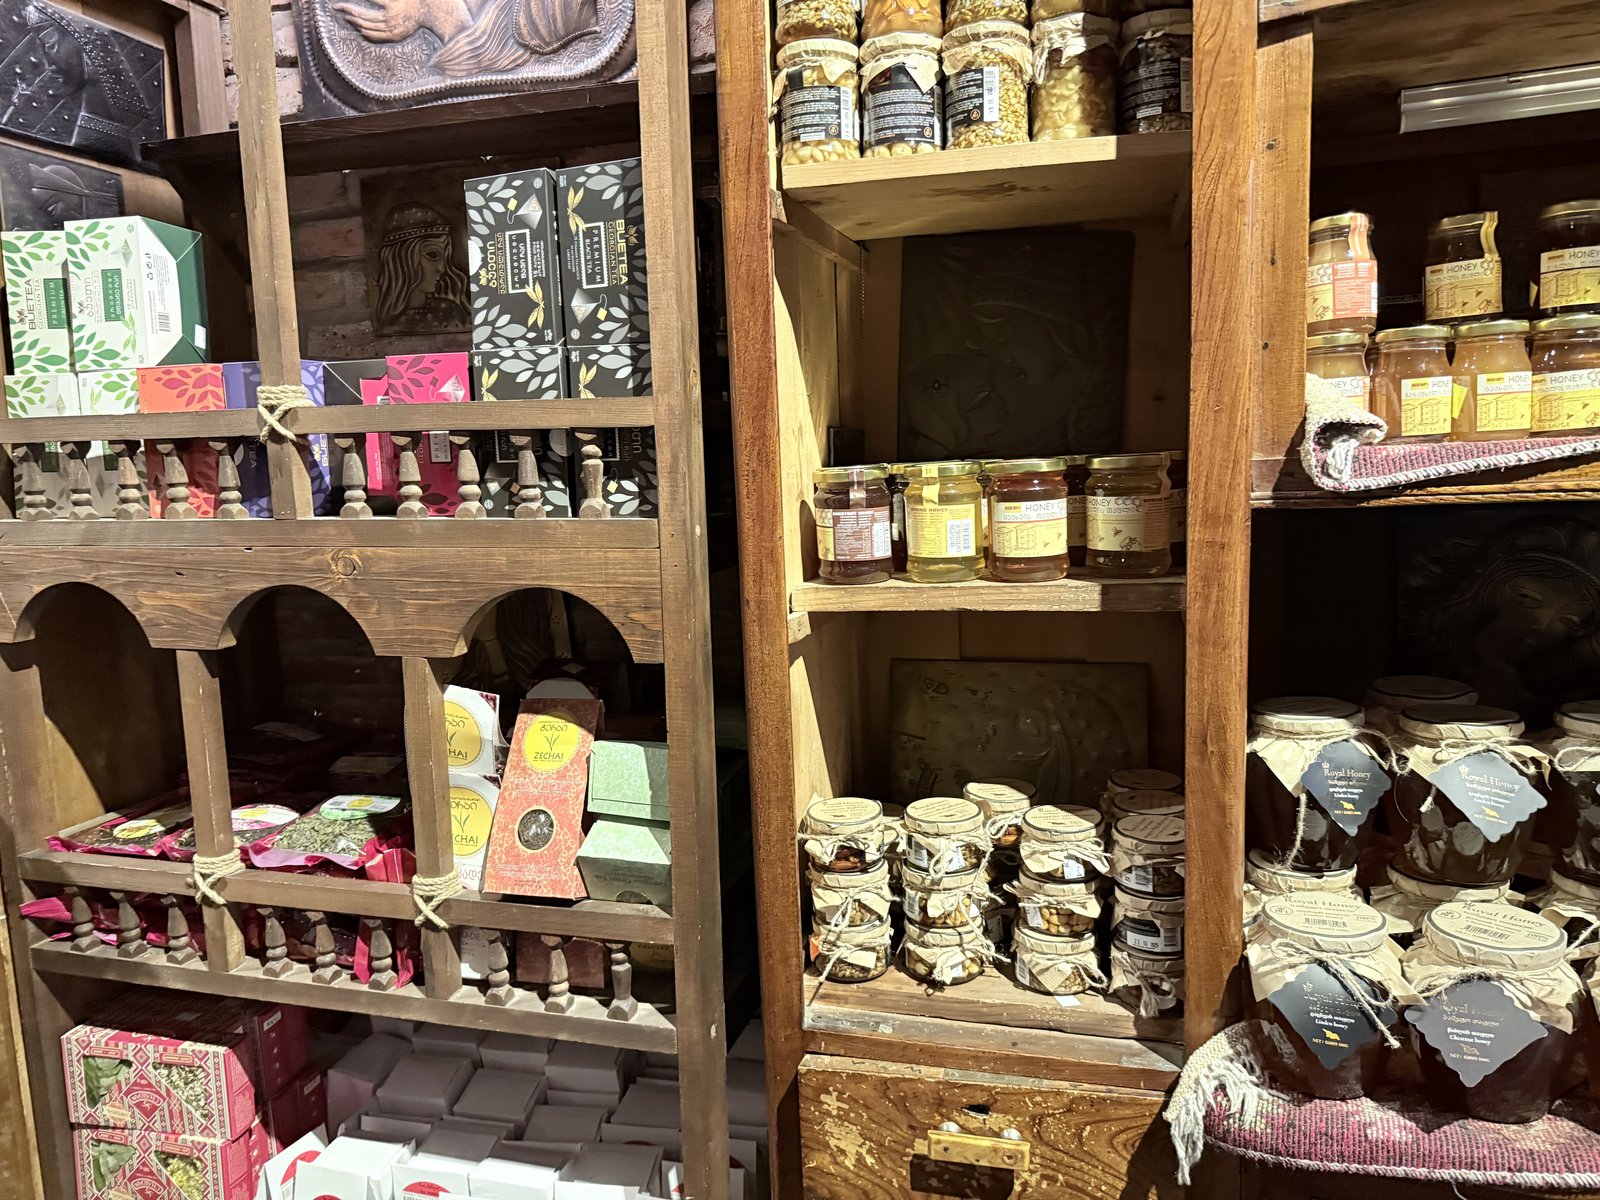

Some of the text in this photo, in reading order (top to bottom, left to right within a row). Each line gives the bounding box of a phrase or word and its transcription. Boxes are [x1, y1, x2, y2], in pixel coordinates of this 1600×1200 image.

[608, 222, 616, 267] GEORGIAN
[592, 230, 602, 282] PREMIUM
[616, 219, 628, 285] BUETEA
[1447, 263, 1478, 273] HONEY
[25, 279, 36, 330] BUETEA
[49, 282, 58, 324] PREMIUM
[1432, 380, 1450, 388] HONE
[1508, 374, 1529, 383] HONE
[1550, 374, 1583, 384] HONEY
[1026, 503, 1055, 512] HONEY
[448, 748, 468, 758] HAI
[1324, 768, 1371, 780] Royal Honey
[1460, 770, 1520, 792] Royal Honey
[450, 801, 478, 810] ეჩაი
[454, 834, 478, 844] CHAI
[1284, 897, 1362, 910] Royal Honey
[1462, 905, 1546, 928] Royal Honey
[1333, 1022, 1348, 1030] honey
